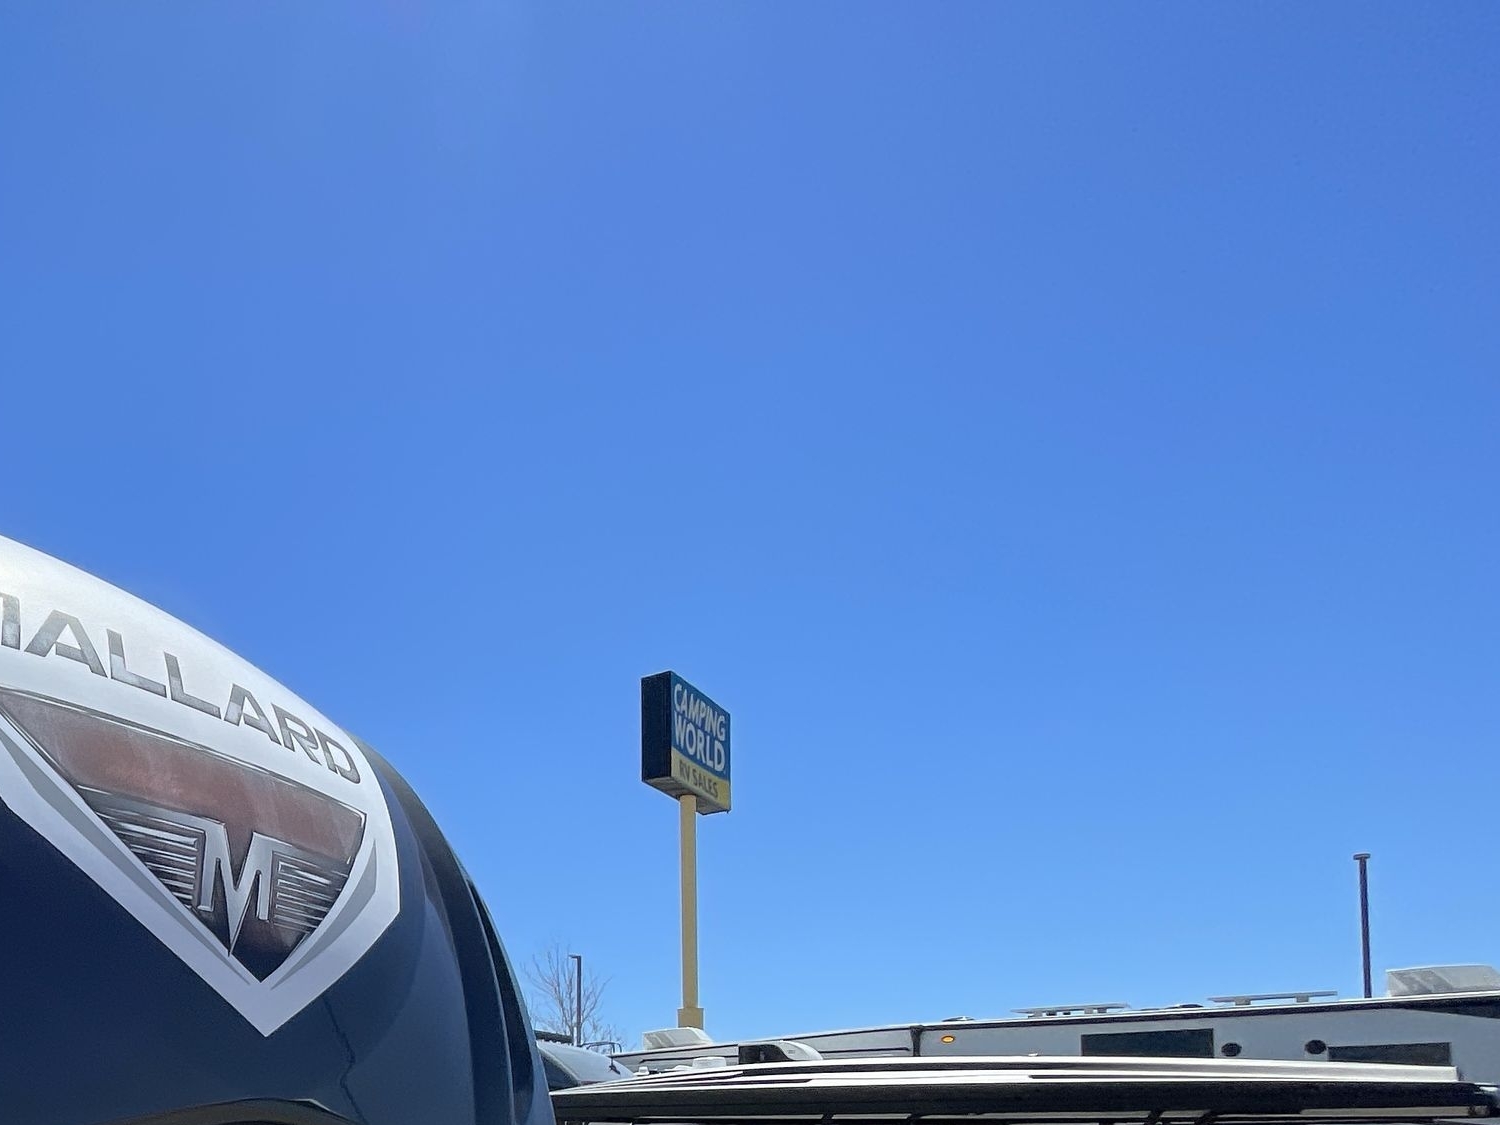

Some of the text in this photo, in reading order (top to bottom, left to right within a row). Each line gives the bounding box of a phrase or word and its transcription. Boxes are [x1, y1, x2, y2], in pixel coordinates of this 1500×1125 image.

[673, 683, 726, 741] CAMPING
[673, 710, 726, 772] WORLD
[679, 759, 719, 798] RV SALES
